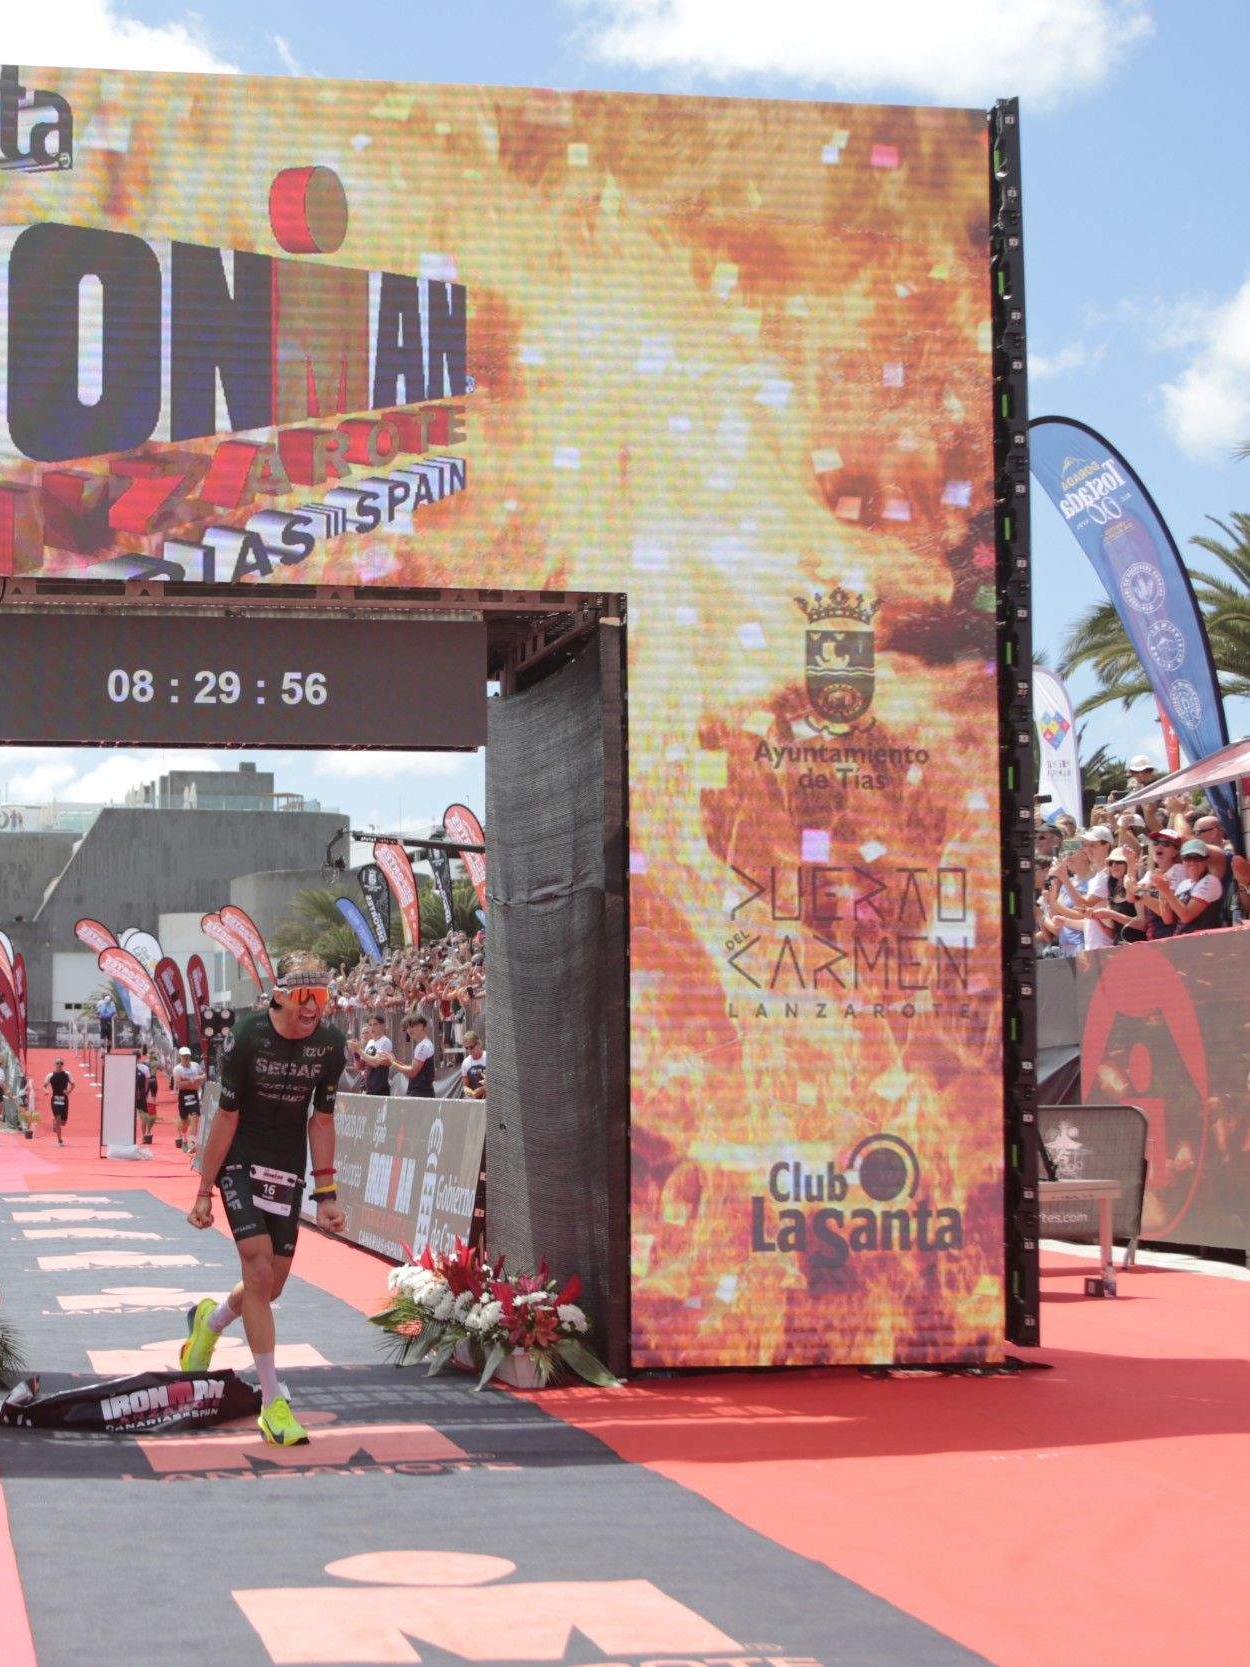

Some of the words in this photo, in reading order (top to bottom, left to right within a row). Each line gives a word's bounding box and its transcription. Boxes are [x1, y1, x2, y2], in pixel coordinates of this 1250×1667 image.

[354, 455, 468, 535] SPAIN
[754, 740, 930, 769] Ayuntamiento
[798, 768, 828, 789] de
[729, 864, 967, 922] PUERTO
[724, 929, 750, 952] DEL
[727, 934, 969, 990] CARMEN
[729, 1002, 971, 1019] LANZAROTE
[263, 1183, 276, 1195] 16
[769, 1160, 848, 1202] Club
[751, 1196, 963, 1267] LaSanta
